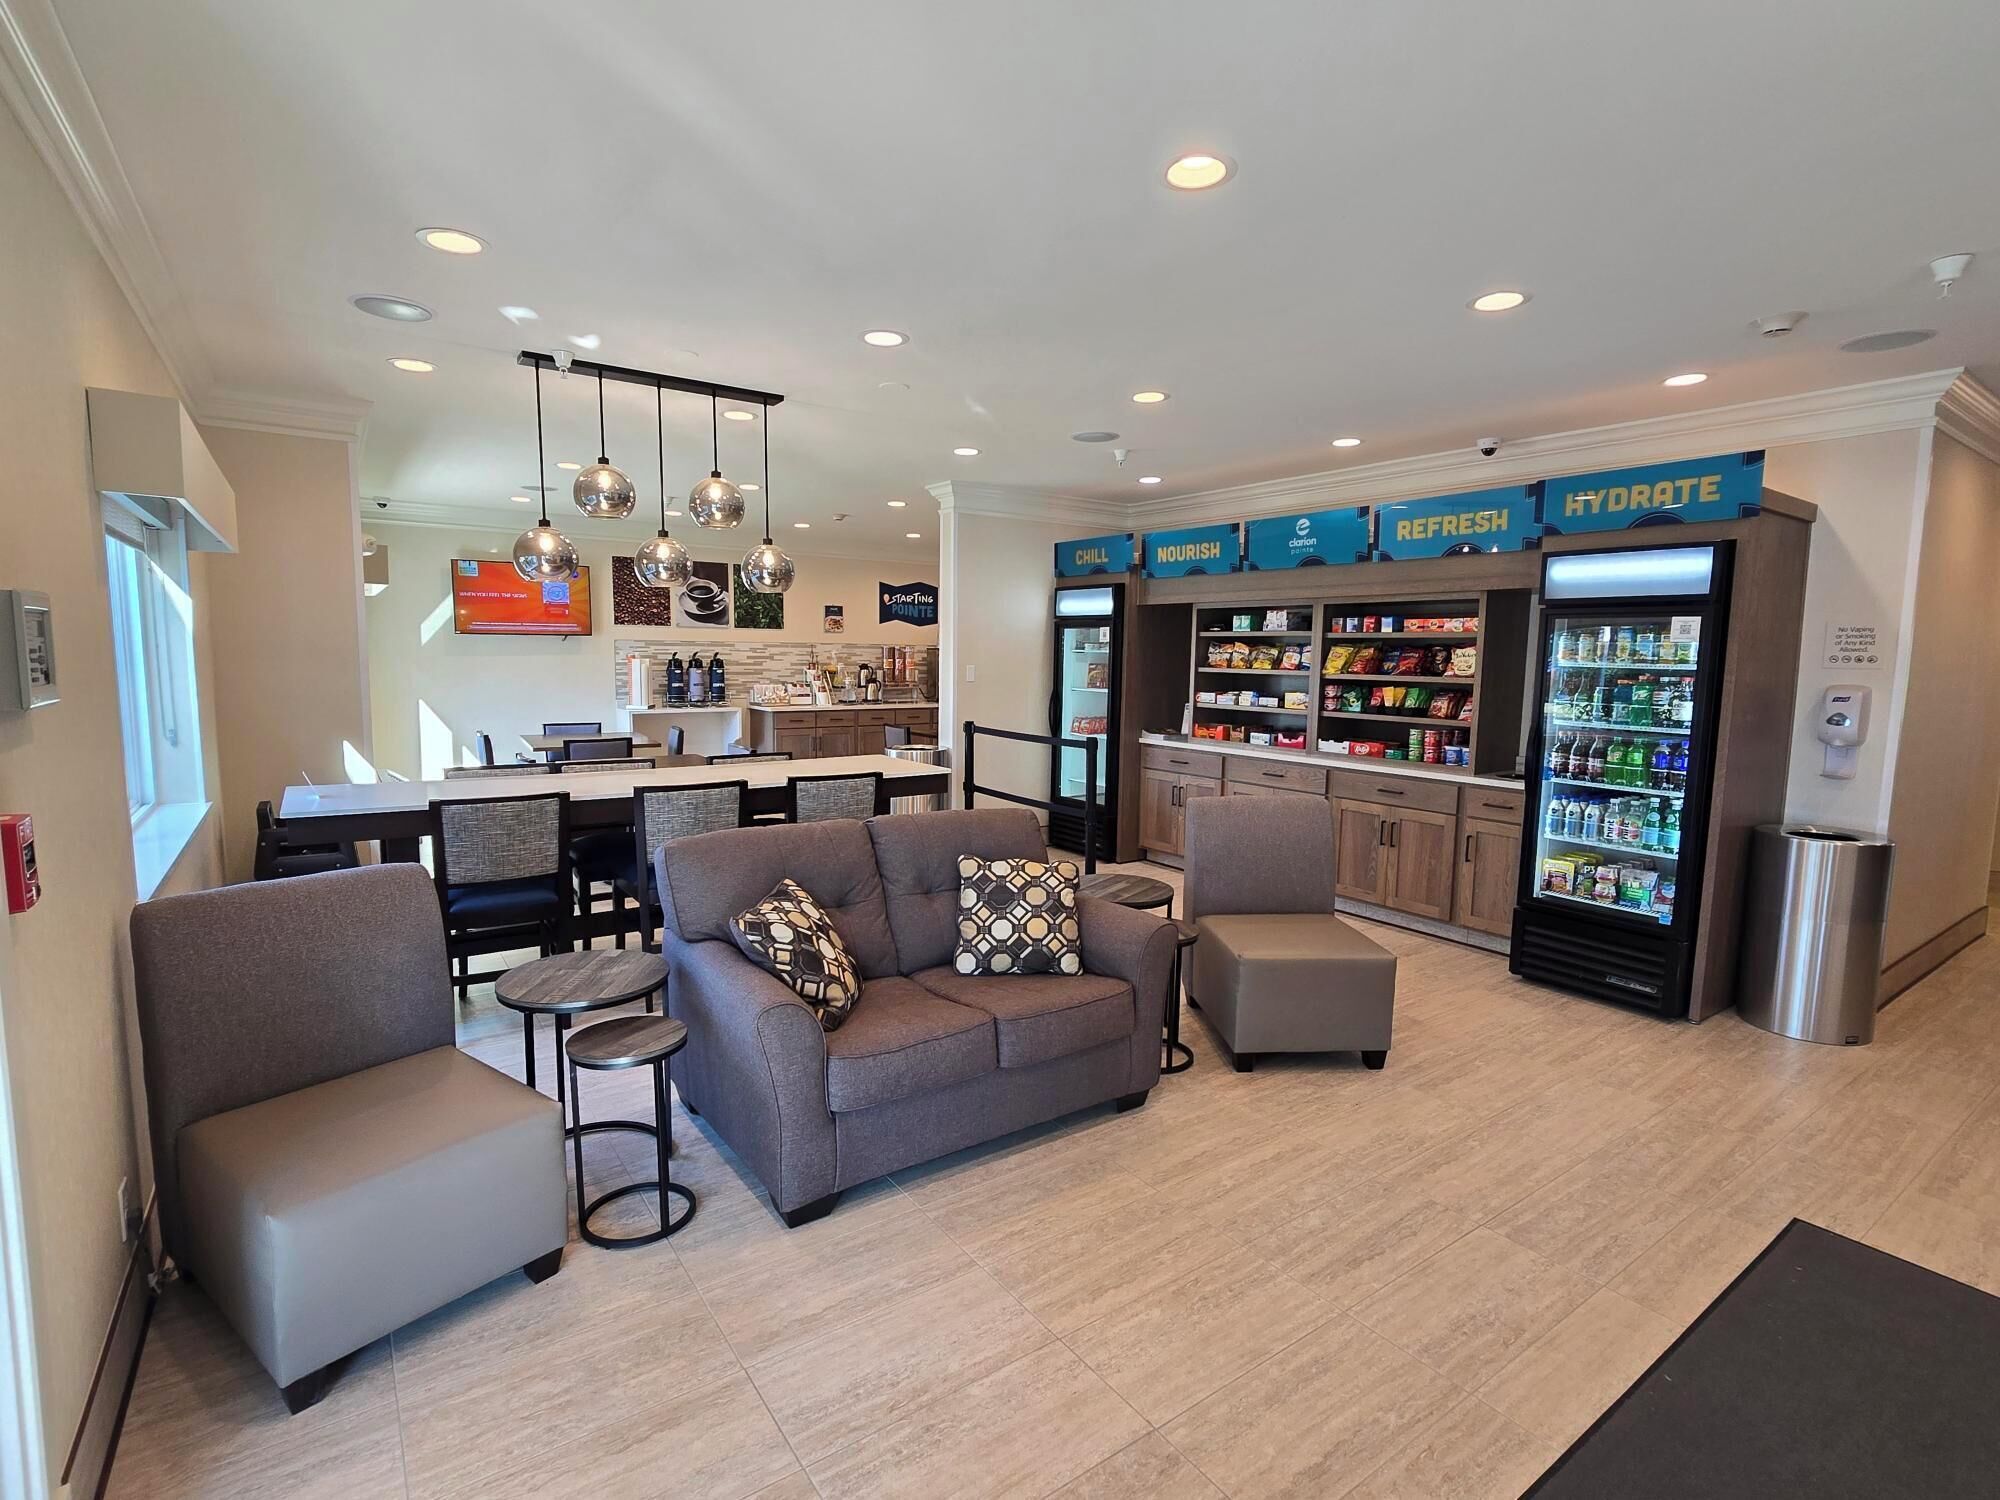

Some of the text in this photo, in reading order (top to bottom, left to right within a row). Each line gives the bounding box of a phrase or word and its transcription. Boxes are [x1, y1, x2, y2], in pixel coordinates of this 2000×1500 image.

[1565, 474, 1722, 517] HYDRATE
[1396, 509, 1509, 541] REFRESH
[1288, 537, 1317, 548] clarion
[1075, 547, 1109, 565] CHILL
[1157, 541, 1220, 563] NOURISH
[1290, 547, 1314, 556] pointe
[891, 592, 934, 604] STARTING
[891, 604, 934, 618] POINTE
[1606, 819, 1615, 838] hint
[1584, 865, 1595, 874] P3
